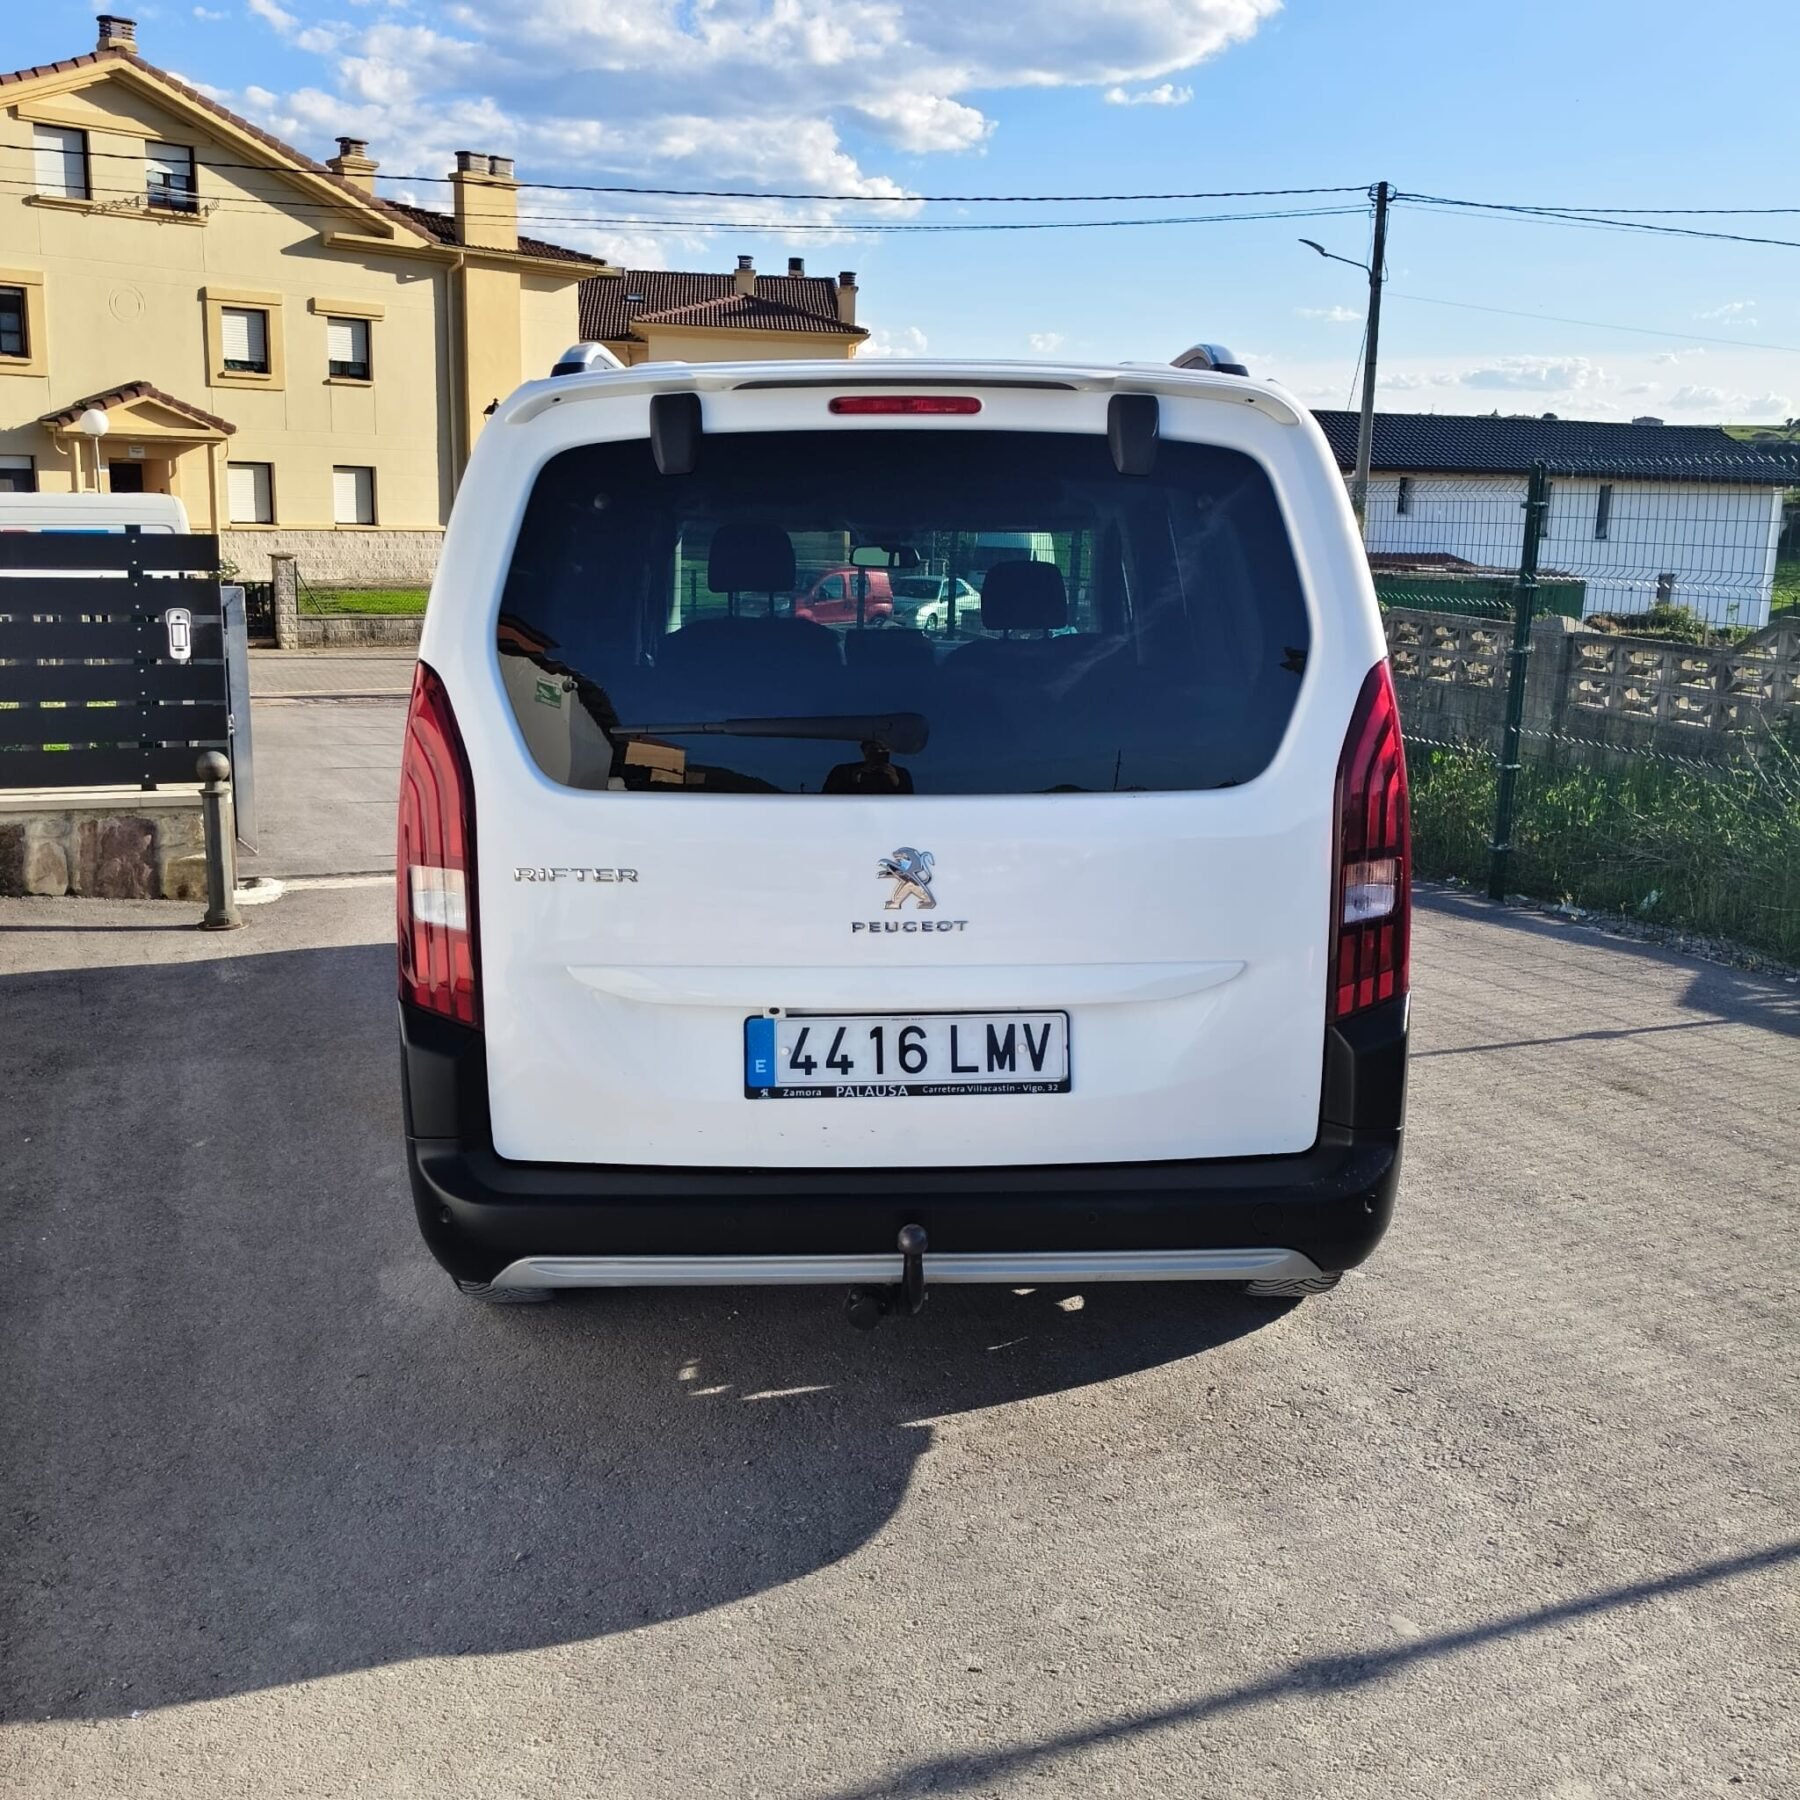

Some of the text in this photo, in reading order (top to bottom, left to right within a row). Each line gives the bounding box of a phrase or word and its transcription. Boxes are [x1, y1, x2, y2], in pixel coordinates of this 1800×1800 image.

[851, 920, 969, 933] PEUGEOT
[755, 1023, 1051, 1076] E 4416 LMV
[783, 1088, 822, 1097] Zamora
[836, 1085, 909, 1098] PALAUSA
[922, 1085, 965, 1094] Carretera
[1047, 1083, 1059, 1092] 32
